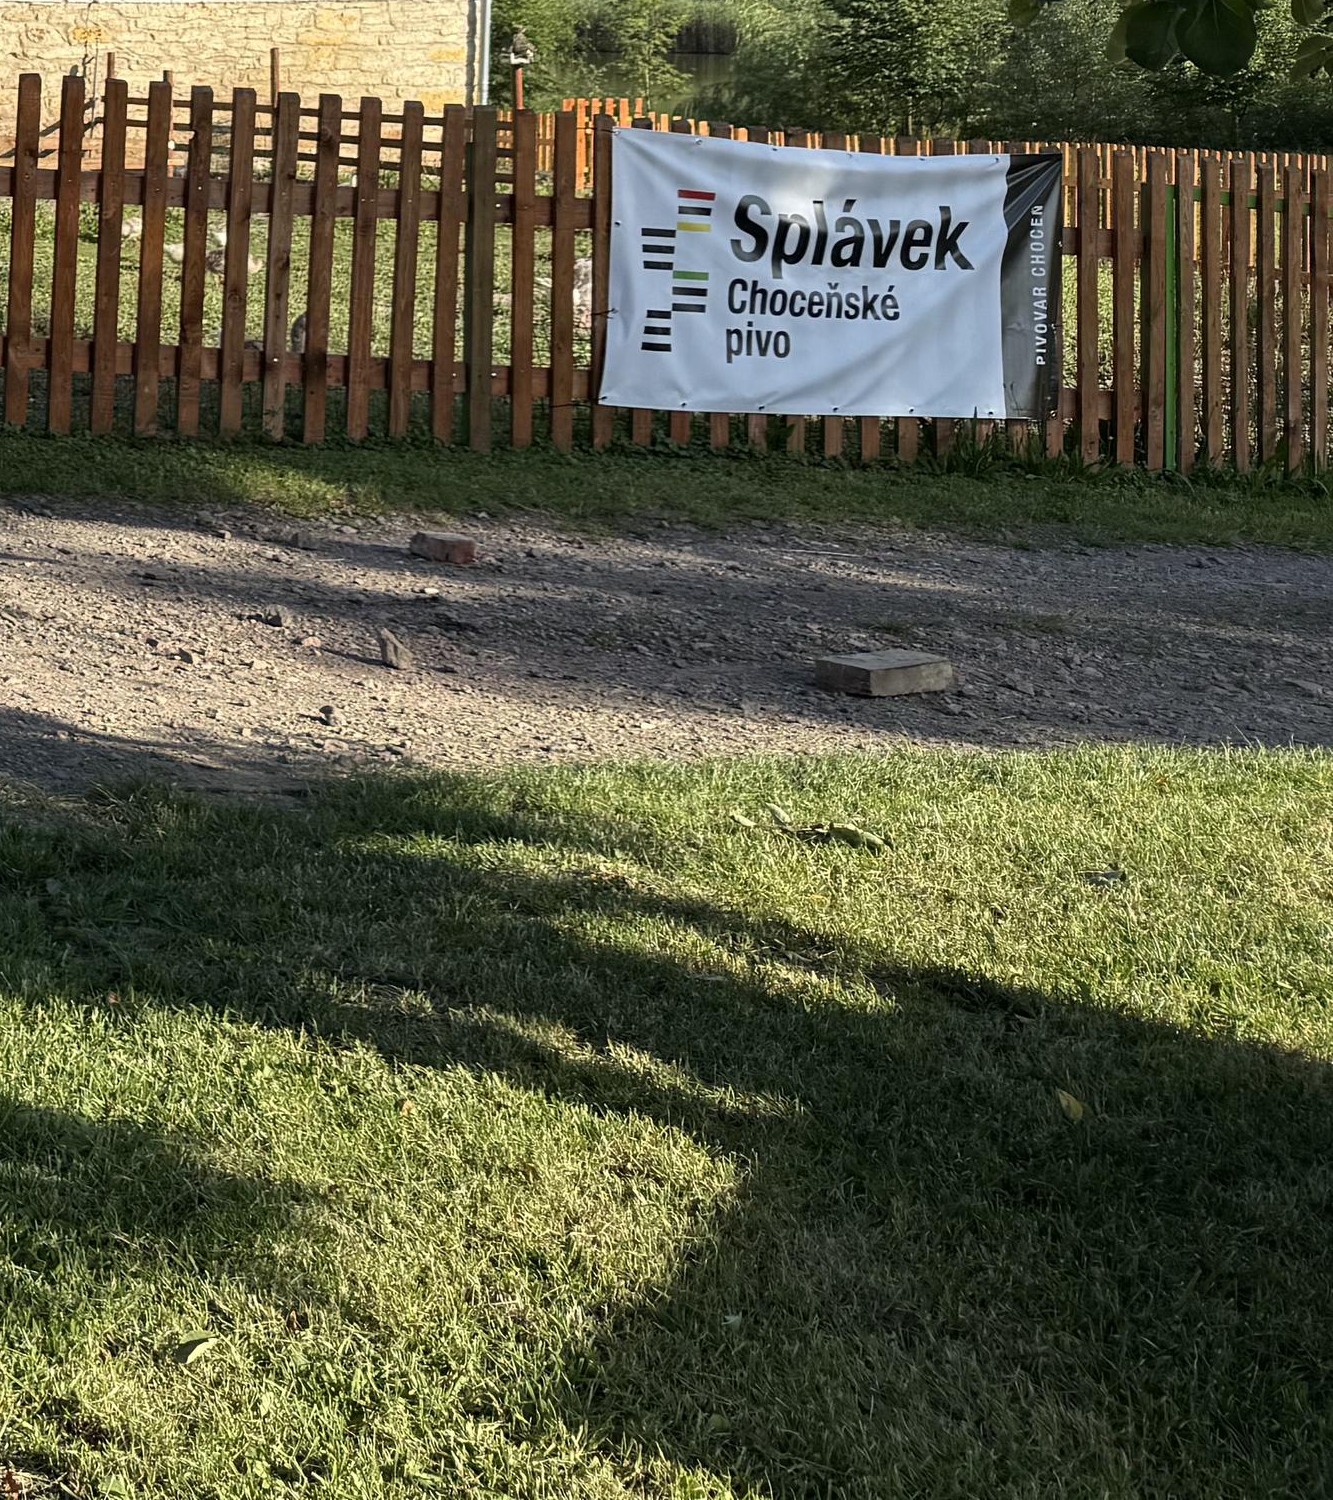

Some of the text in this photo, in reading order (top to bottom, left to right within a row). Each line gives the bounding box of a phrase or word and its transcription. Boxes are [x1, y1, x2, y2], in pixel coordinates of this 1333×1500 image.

[730, 194, 975, 279] Splávek
[727, 278, 901, 321] Choceňské
[1033, 286, 1047, 365] PIVOVAR
[725, 321, 791, 364] pivo
